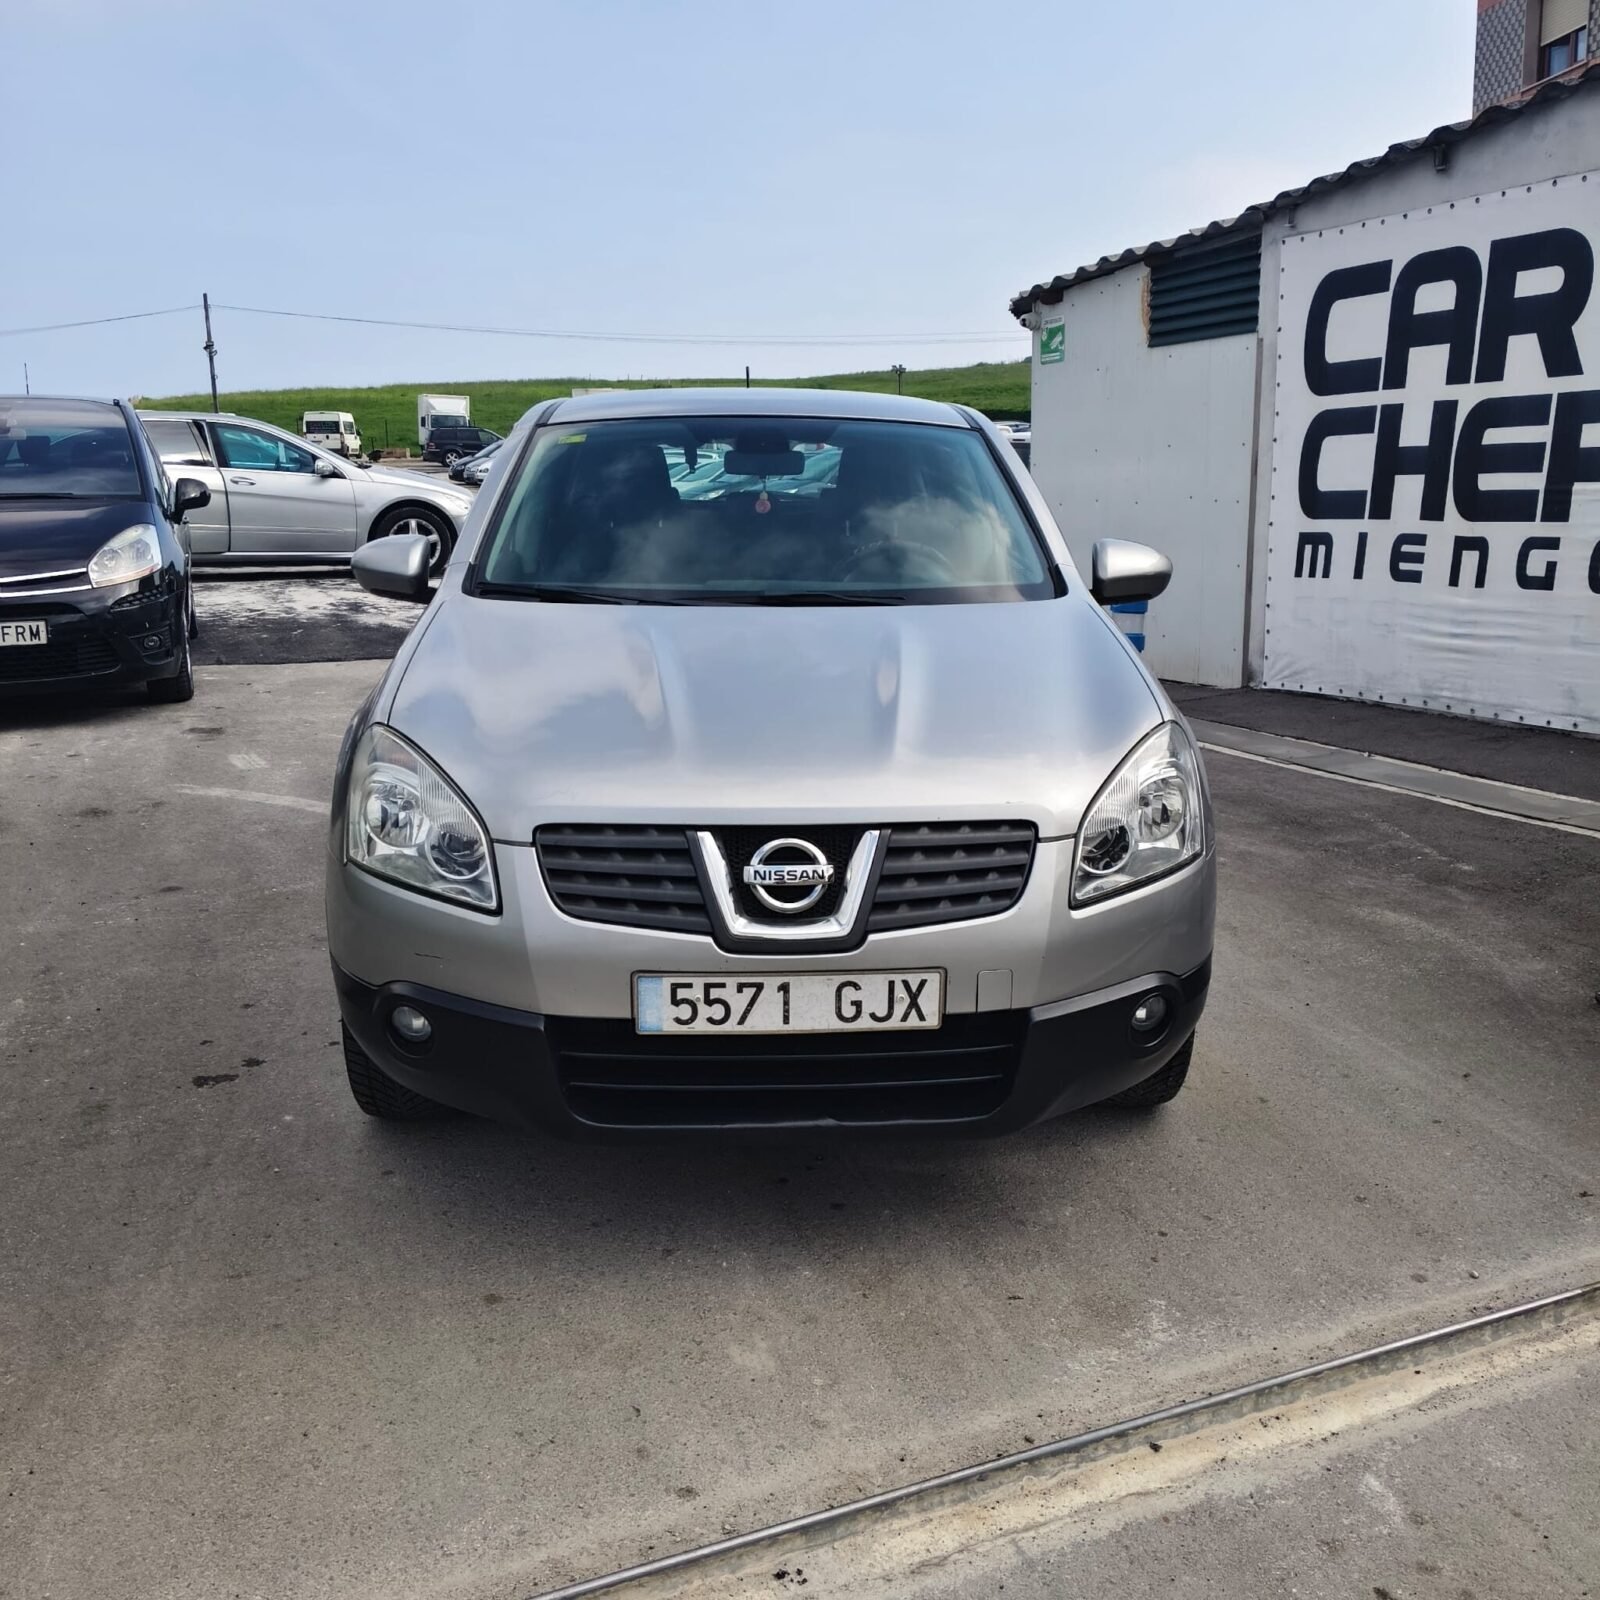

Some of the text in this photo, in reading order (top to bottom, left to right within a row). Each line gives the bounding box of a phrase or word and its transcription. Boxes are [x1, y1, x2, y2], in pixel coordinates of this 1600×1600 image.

[1304, 227, 1595, 397] CAR
[1294, 531, 1600, 594] MIENG
[1, 624, 41, 643] FRM
[753, 869, 826, 882] NISSAN
[669, 978, 929, 1026] 5571 GJX
